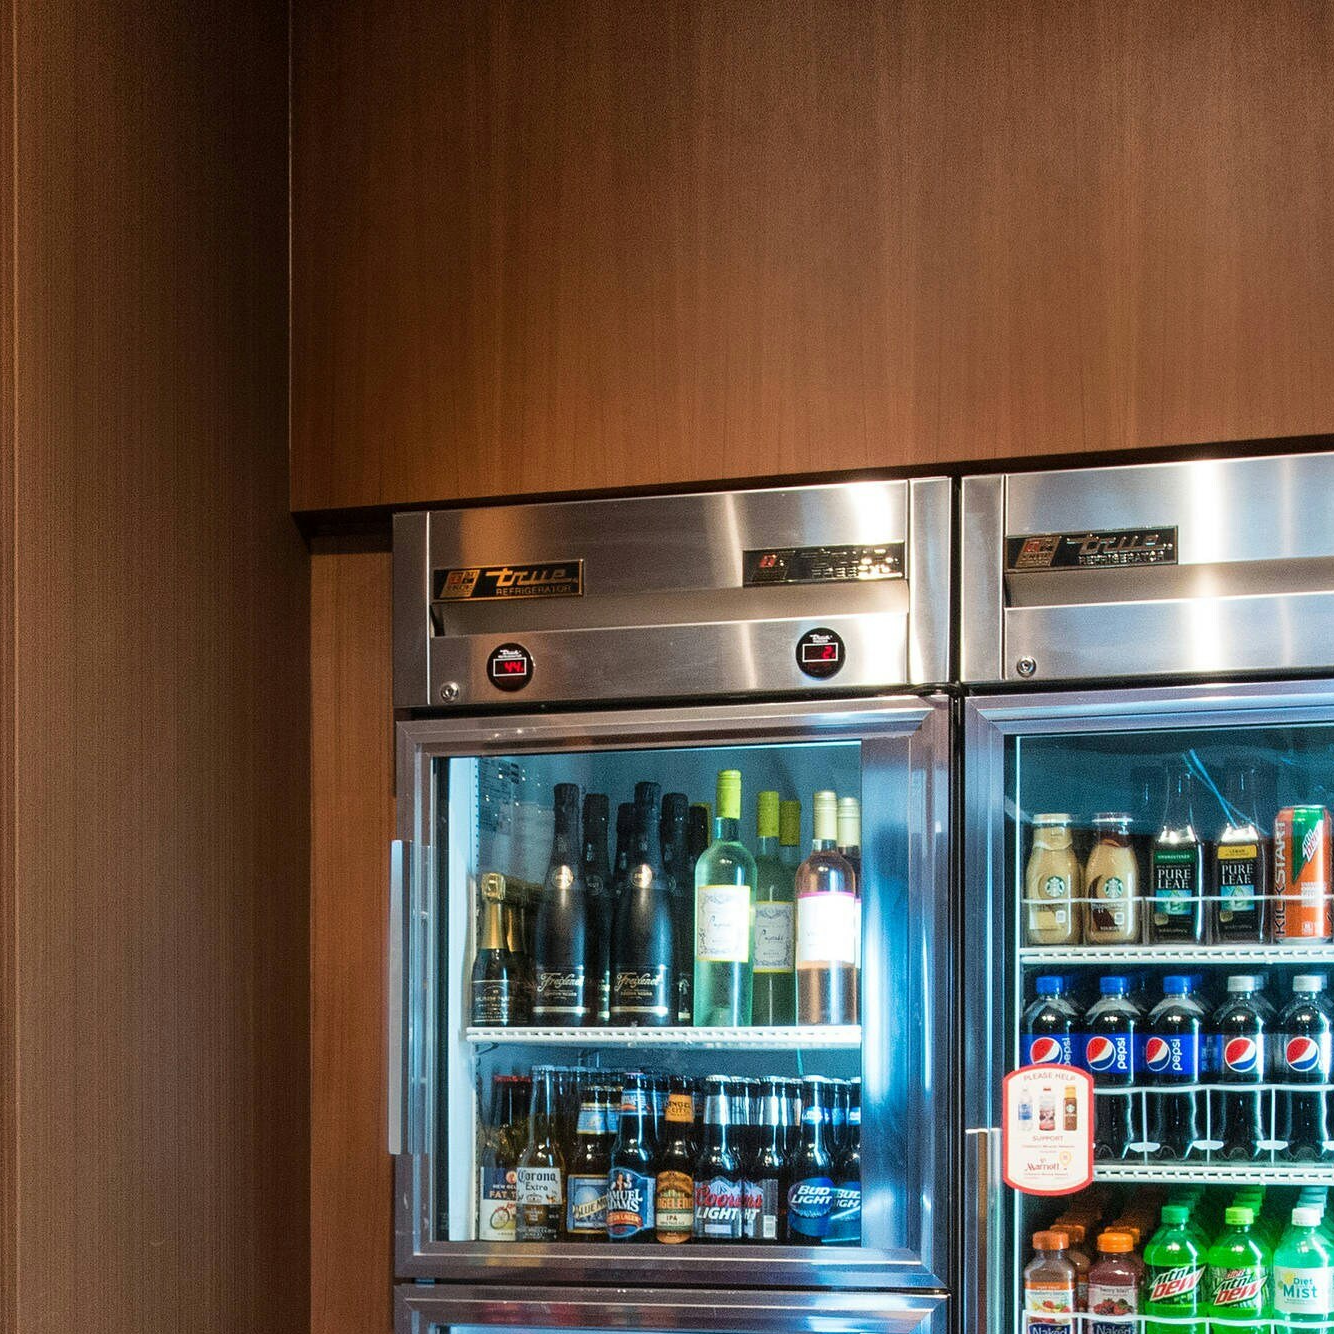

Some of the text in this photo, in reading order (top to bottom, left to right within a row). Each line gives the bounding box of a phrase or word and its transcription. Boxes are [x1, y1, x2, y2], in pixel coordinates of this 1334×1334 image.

[496, 585, 571, 596] REFRIGERATOR
[1158, 868, 1191, 880] PURE
[1221, 863, 1255, 875] PURE
[1158, 879, 1189, 889] LEAF
[1222, 874, 1252, 886] LEAF
[1117, 1036, 1128, 1071] pepsi
[1171, 1036, 1183, 1072] pepsi
[1023, 1071, 1077, 1081] PLEASE HELP
[517, 1168, 559, 1185] Corona
[525, 1181, 549, 1192] Extra
[797, 1185, 830, 1196] BUD
[489, 1190, 508, 1200] FAT
[608, 1189, 643, 1202] MUEL
[791, 1194, 833, 1204] LIGHT
[696, 1207, 739, 1220] LIGHT
[1293, 1277, 1313, 1286] Diet
[1283, 1285, 1318, 1299] Mist
